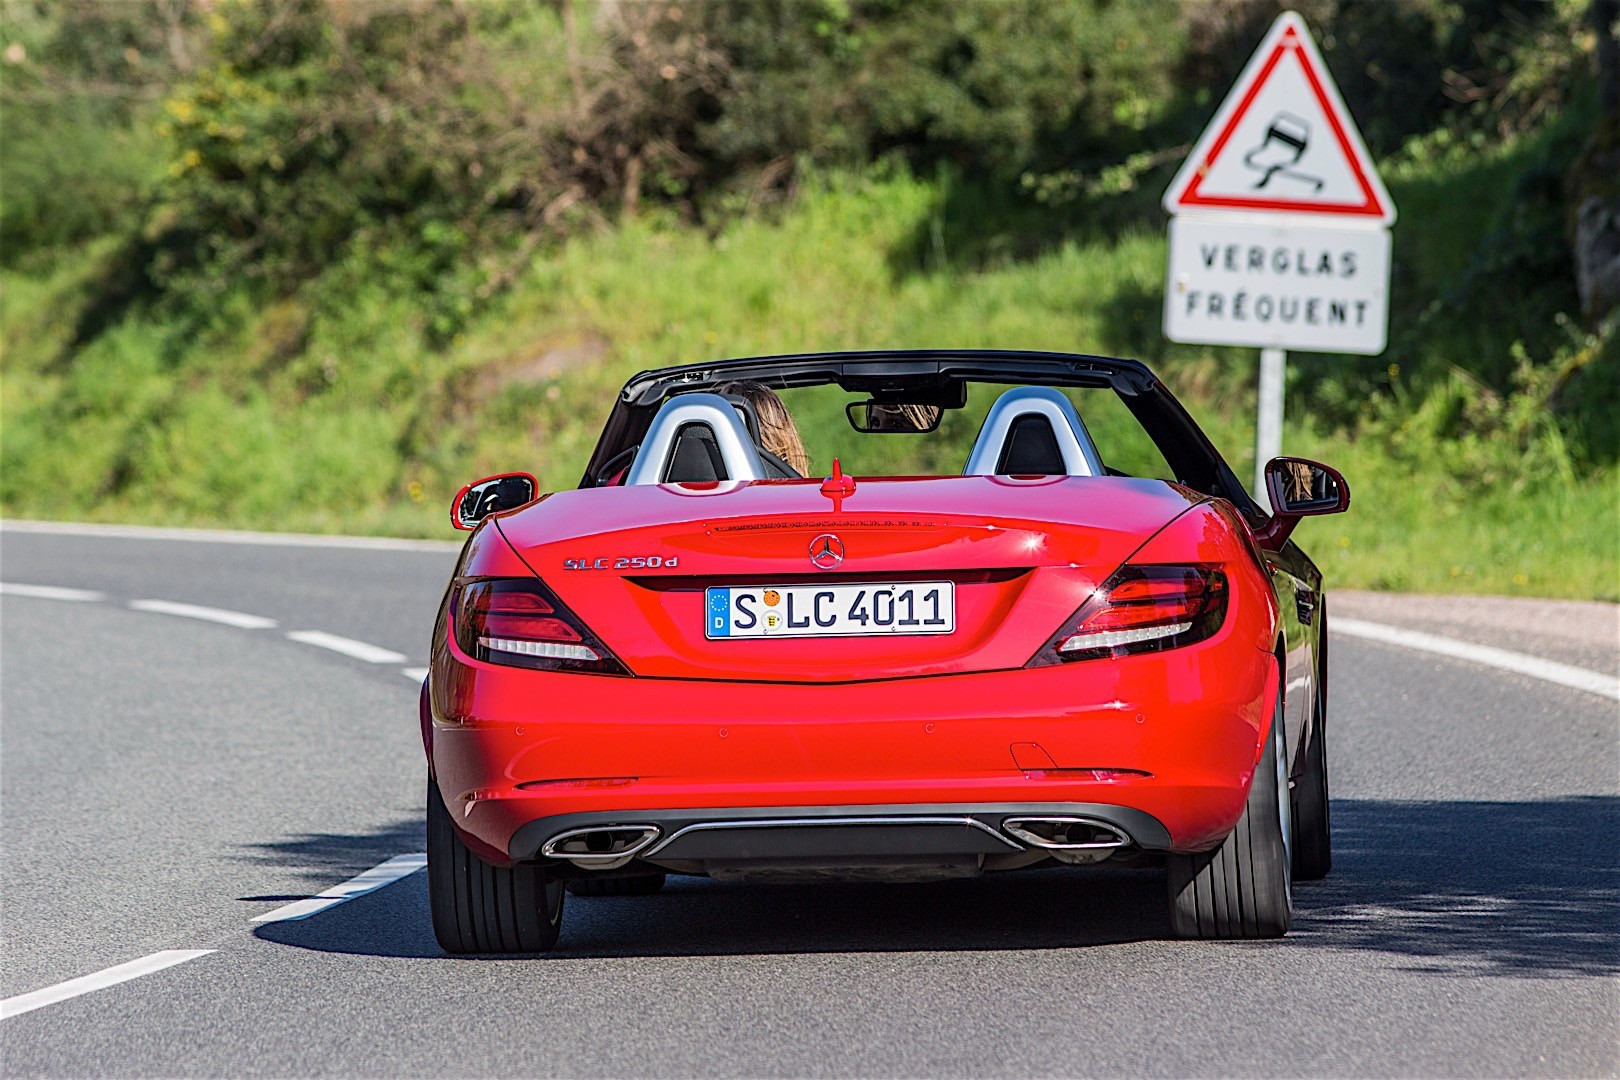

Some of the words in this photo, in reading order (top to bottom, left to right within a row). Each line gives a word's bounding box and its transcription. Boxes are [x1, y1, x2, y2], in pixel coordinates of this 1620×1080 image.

[1201, 243, 1358, 279] VERGLAS
[1185, 286, 1370, 328] FRÉQUENT
[563, 557, 609, 570] SLC
[714, 616, 724, 629] D
[734, 594, 757, 629] S
[787, 591, 837, 629] LC
[848, 589, 946, 626] 4011
